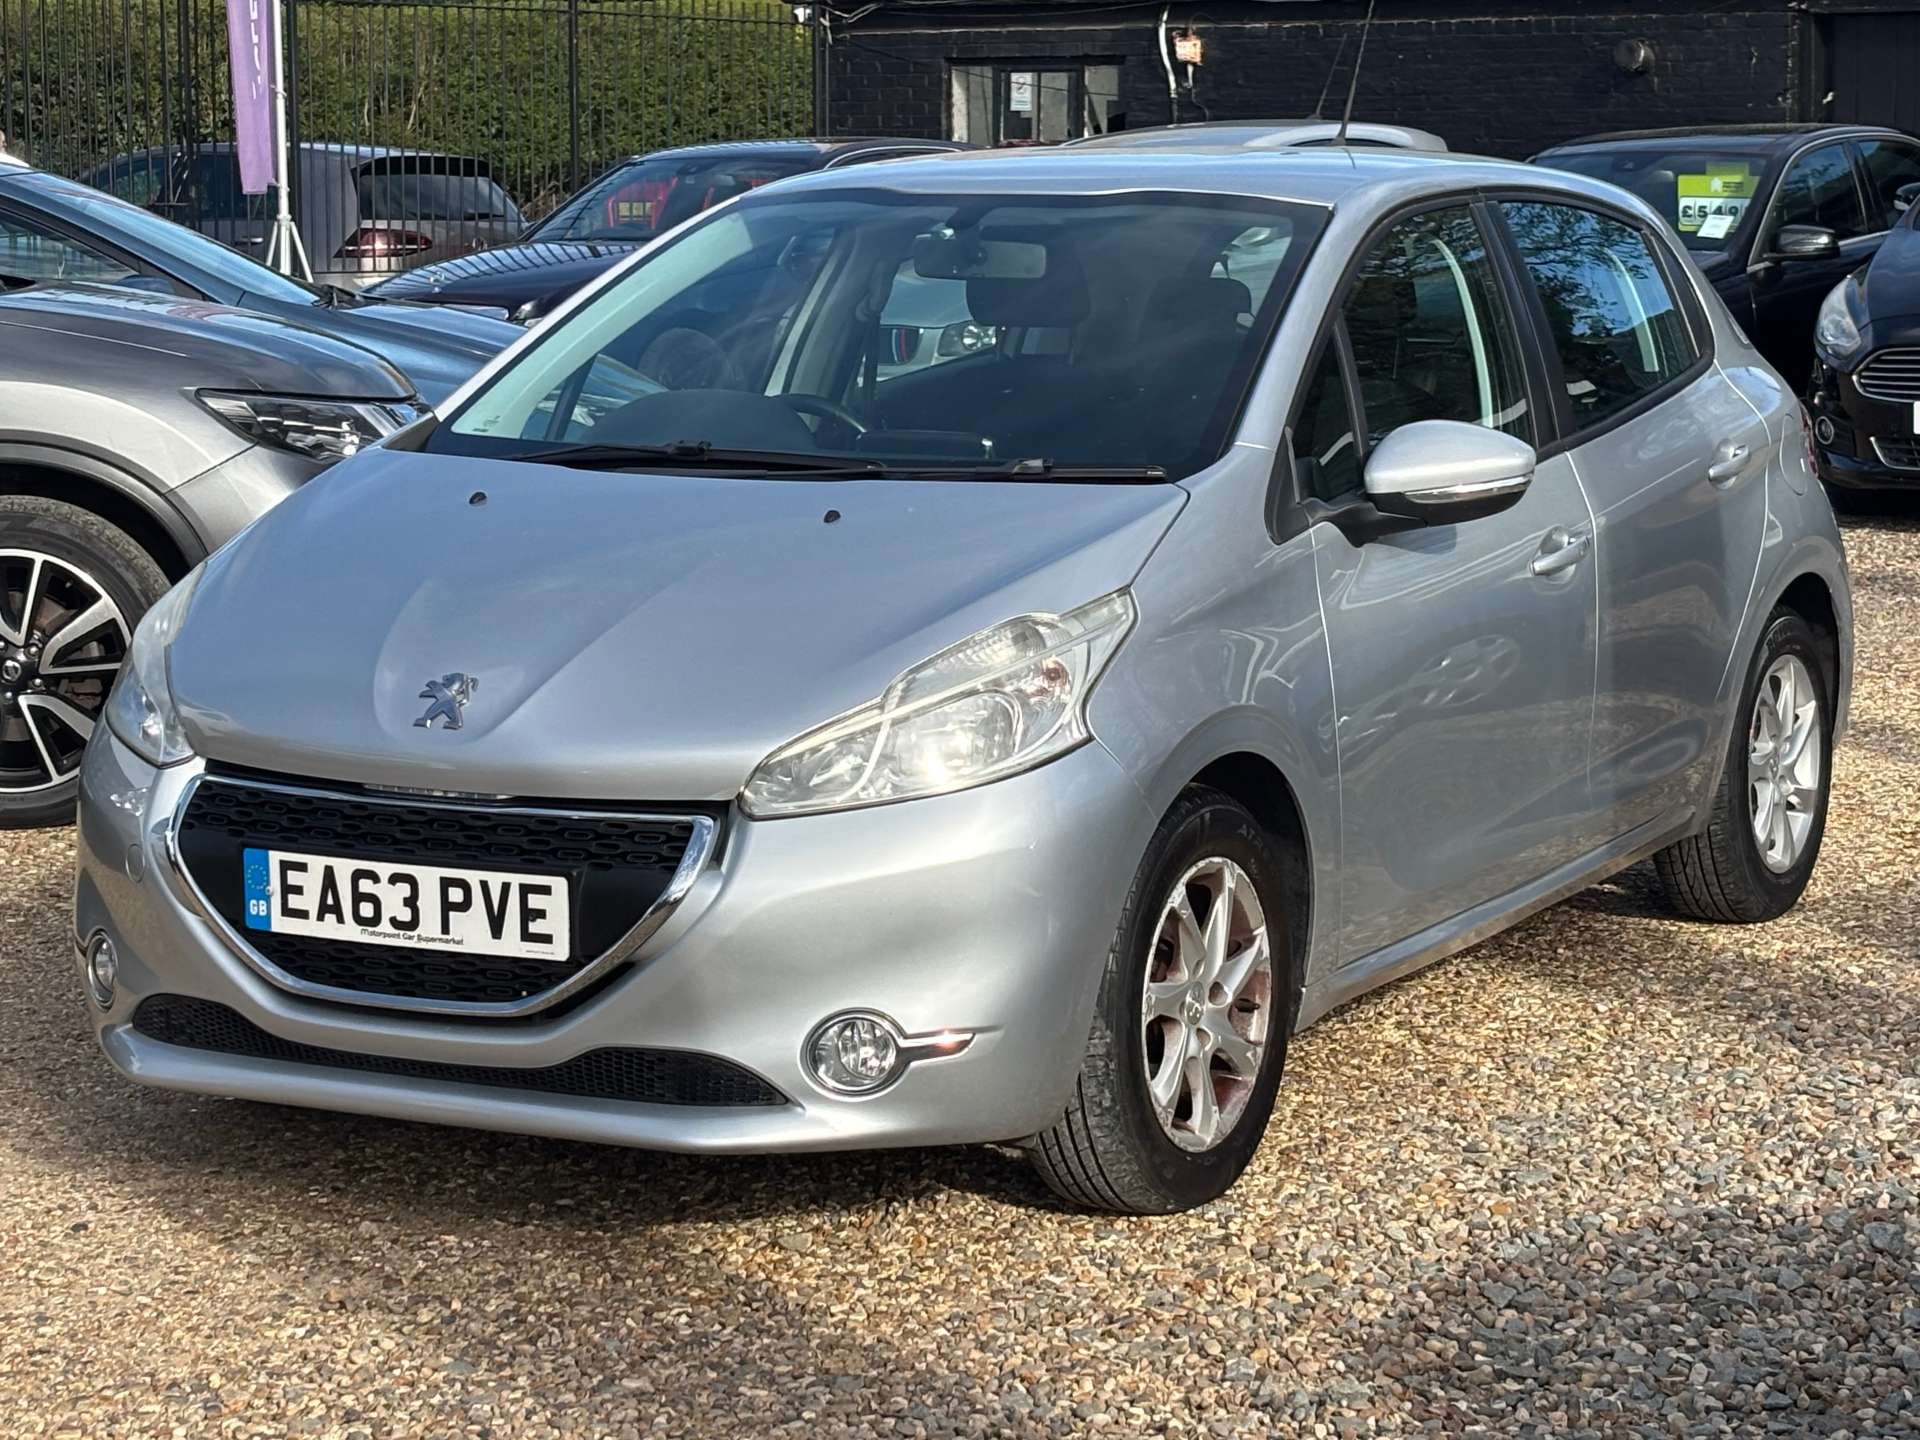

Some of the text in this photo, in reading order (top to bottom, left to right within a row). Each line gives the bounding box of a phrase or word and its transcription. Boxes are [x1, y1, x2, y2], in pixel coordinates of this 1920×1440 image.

[249, 899, 267, 915] GB
[279, 859, 554, 945] EA63 PVE
[360, 928, 464, 946] Motorpoint Car Supermarket
